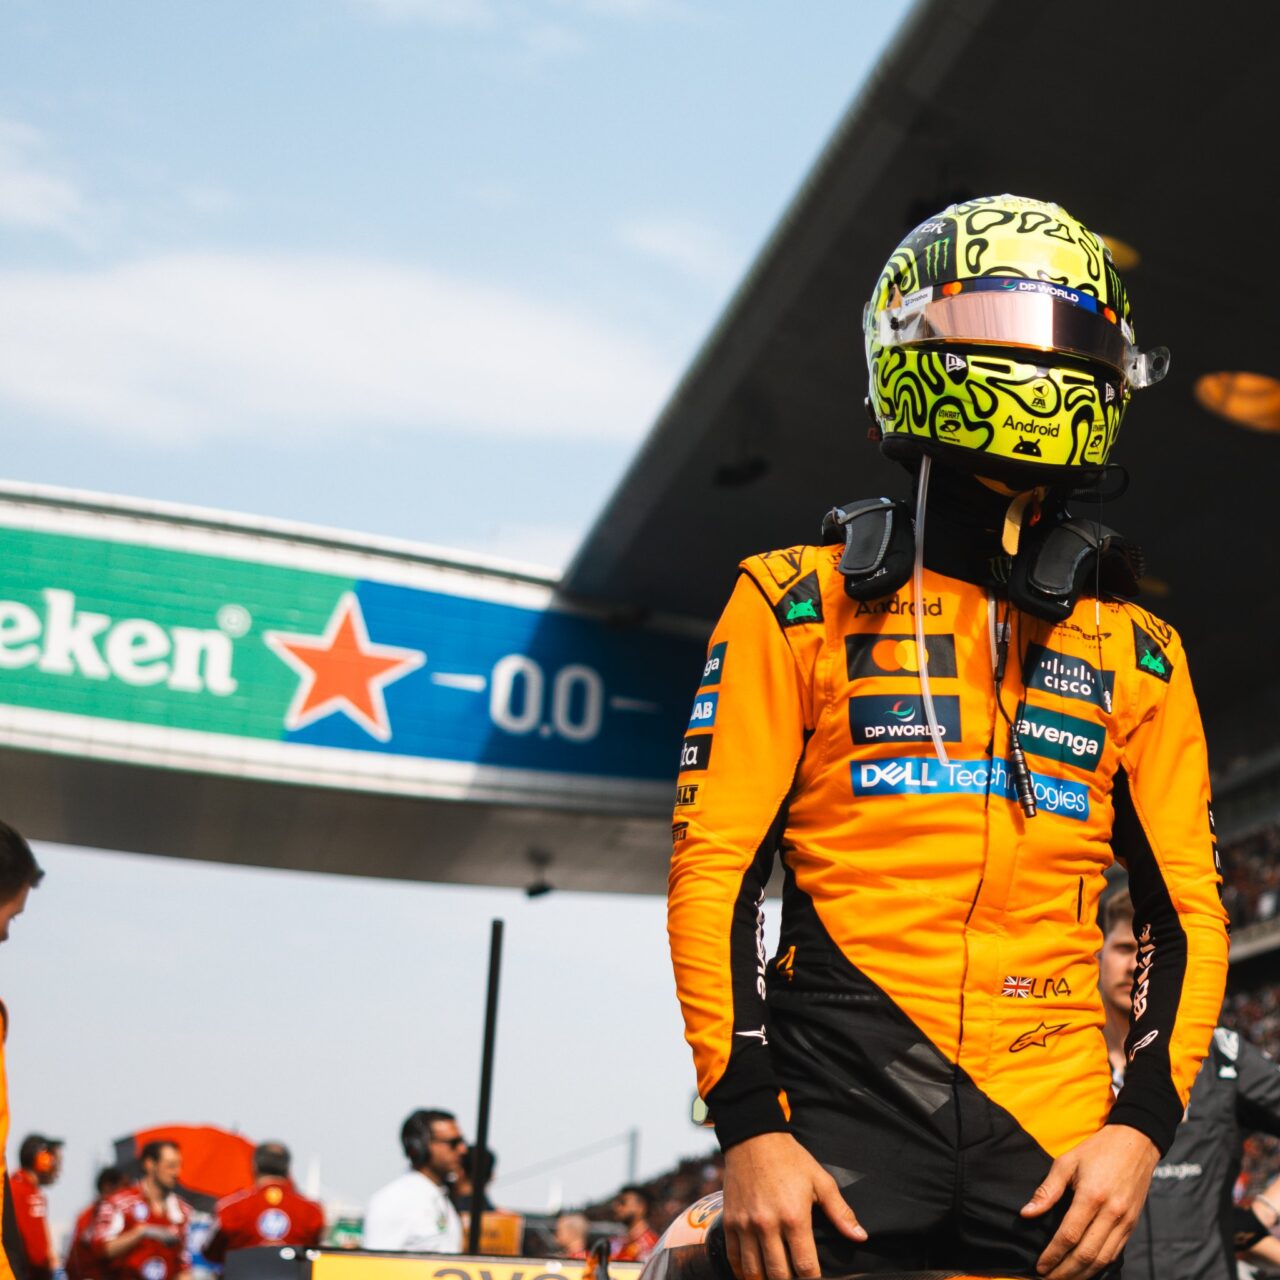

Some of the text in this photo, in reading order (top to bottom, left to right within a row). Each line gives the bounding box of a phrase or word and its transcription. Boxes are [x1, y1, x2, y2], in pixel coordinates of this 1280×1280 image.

[1019, 282, 1079, 302] DP WORLD
[1002, 414, 1059, 437] Android
[865, 723, 946, 738] DP WORLD
[1016, 719, 1098, 755] avenga
[861, 761, 937, 788] DELL
